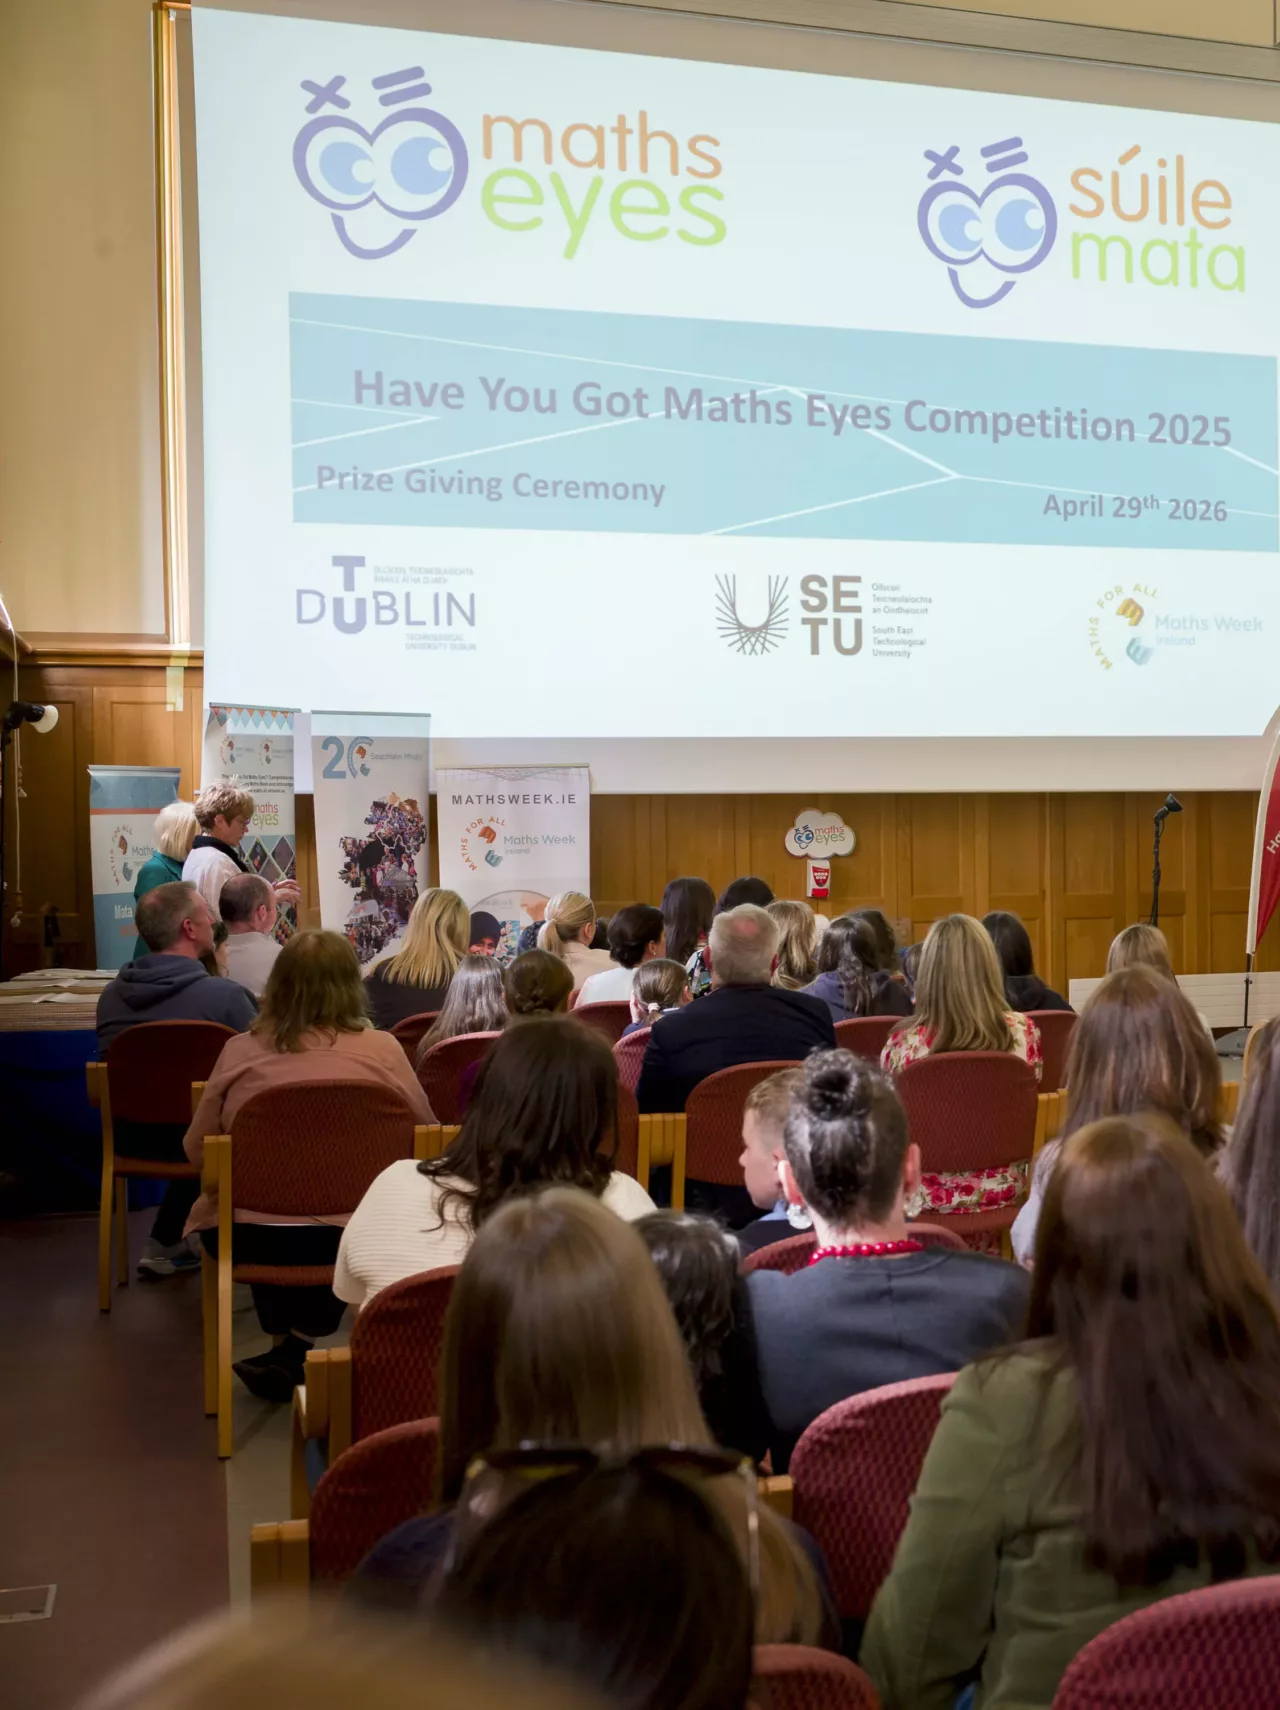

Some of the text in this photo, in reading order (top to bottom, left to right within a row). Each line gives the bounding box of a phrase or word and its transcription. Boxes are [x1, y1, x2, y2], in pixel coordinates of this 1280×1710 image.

[481, 110, 723, 179] maths
[1068, 144, 1233, 230] súile
[480, 168, 727, 260] eyes
[1070, 227, 1247, 293] mata
[353, 369, 1232, 448] Have You Got Maths Eyes Competition 2025
[316, 464, 666, 508] Prize Giving Ceremony
[1042, 493, 1104, 522] April
[1167, 498, 1228, 522] 2026
[872, 625, 914, 635] South East
[1154, 614, 1264, 632] Maths Week
[872, 637, 927, 647] Technological
[872, 648, 912, 659] University
[451, 793, 577, 806] MATHSWEEK.IE
[814, 824, 845, 835] maths
[503, 834, 577, 845] Maths Week
[815, 832, 846, 846] eyes
